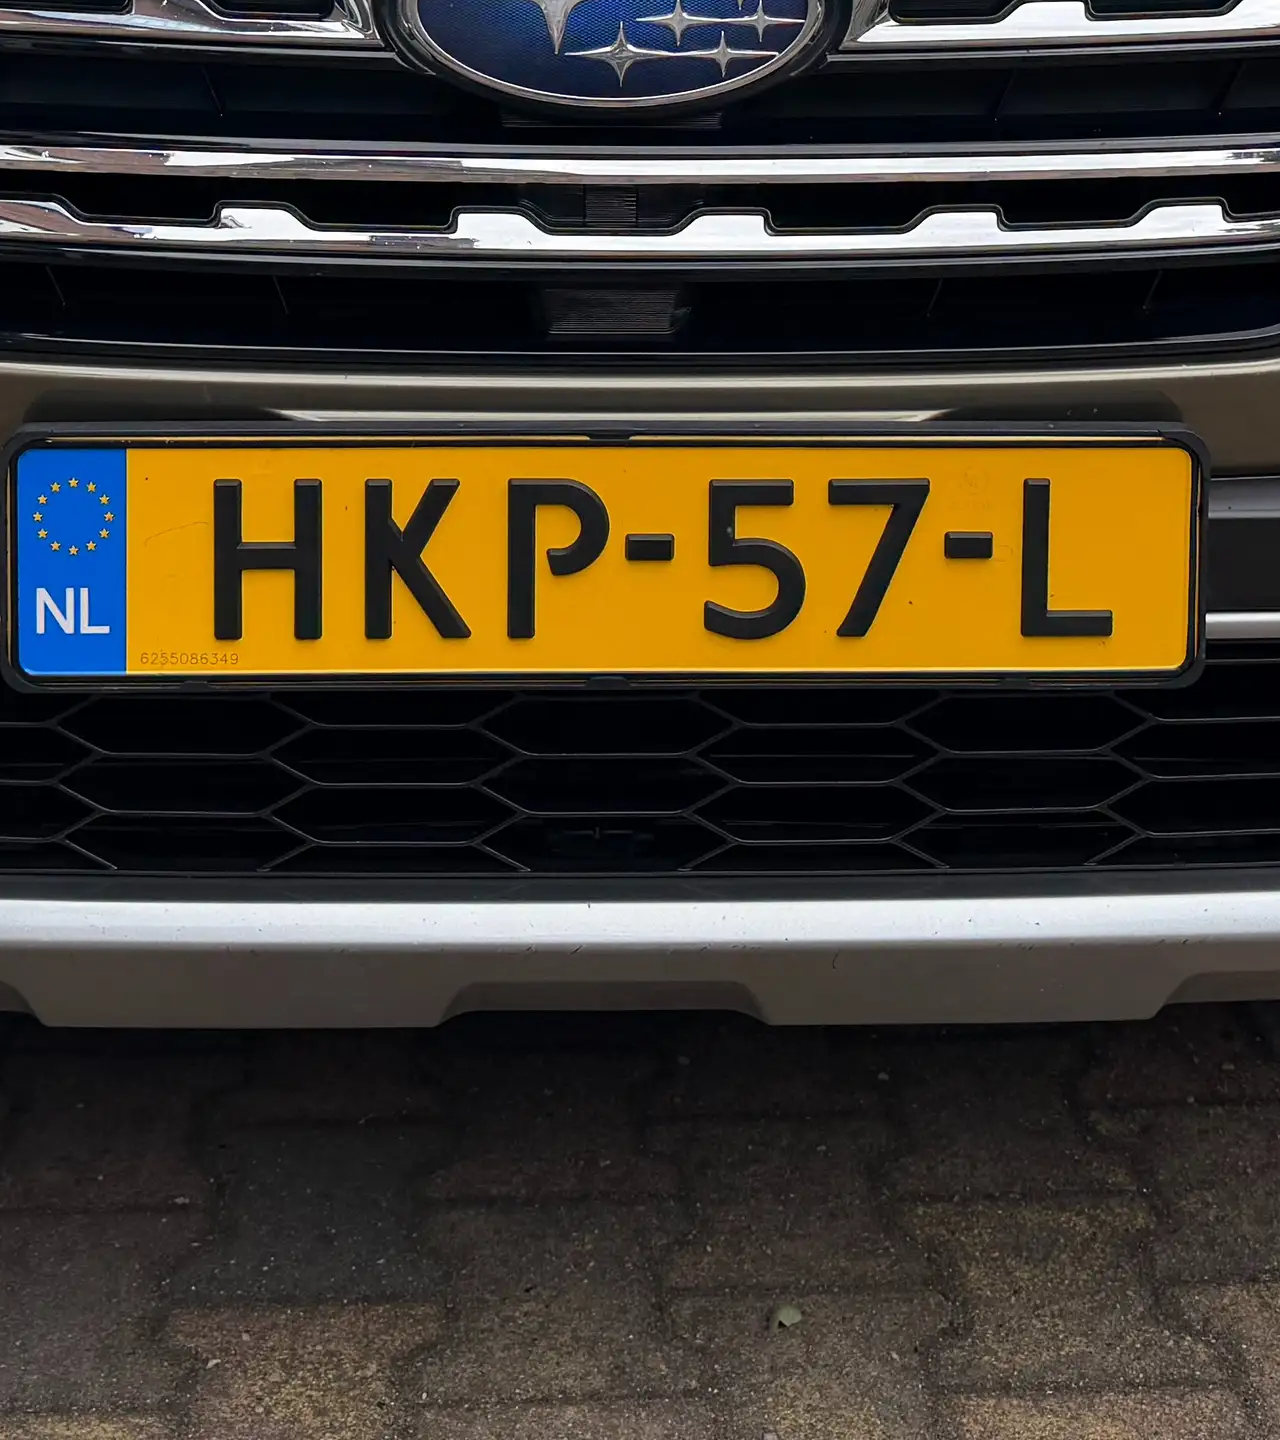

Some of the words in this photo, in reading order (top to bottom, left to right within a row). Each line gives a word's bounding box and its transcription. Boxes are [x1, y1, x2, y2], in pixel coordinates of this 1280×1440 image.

[213, 478, 1113, 639] HKP-57-L
[36, 587, 110, 635] NL
[139, 652, 240, 666] 6255086349
